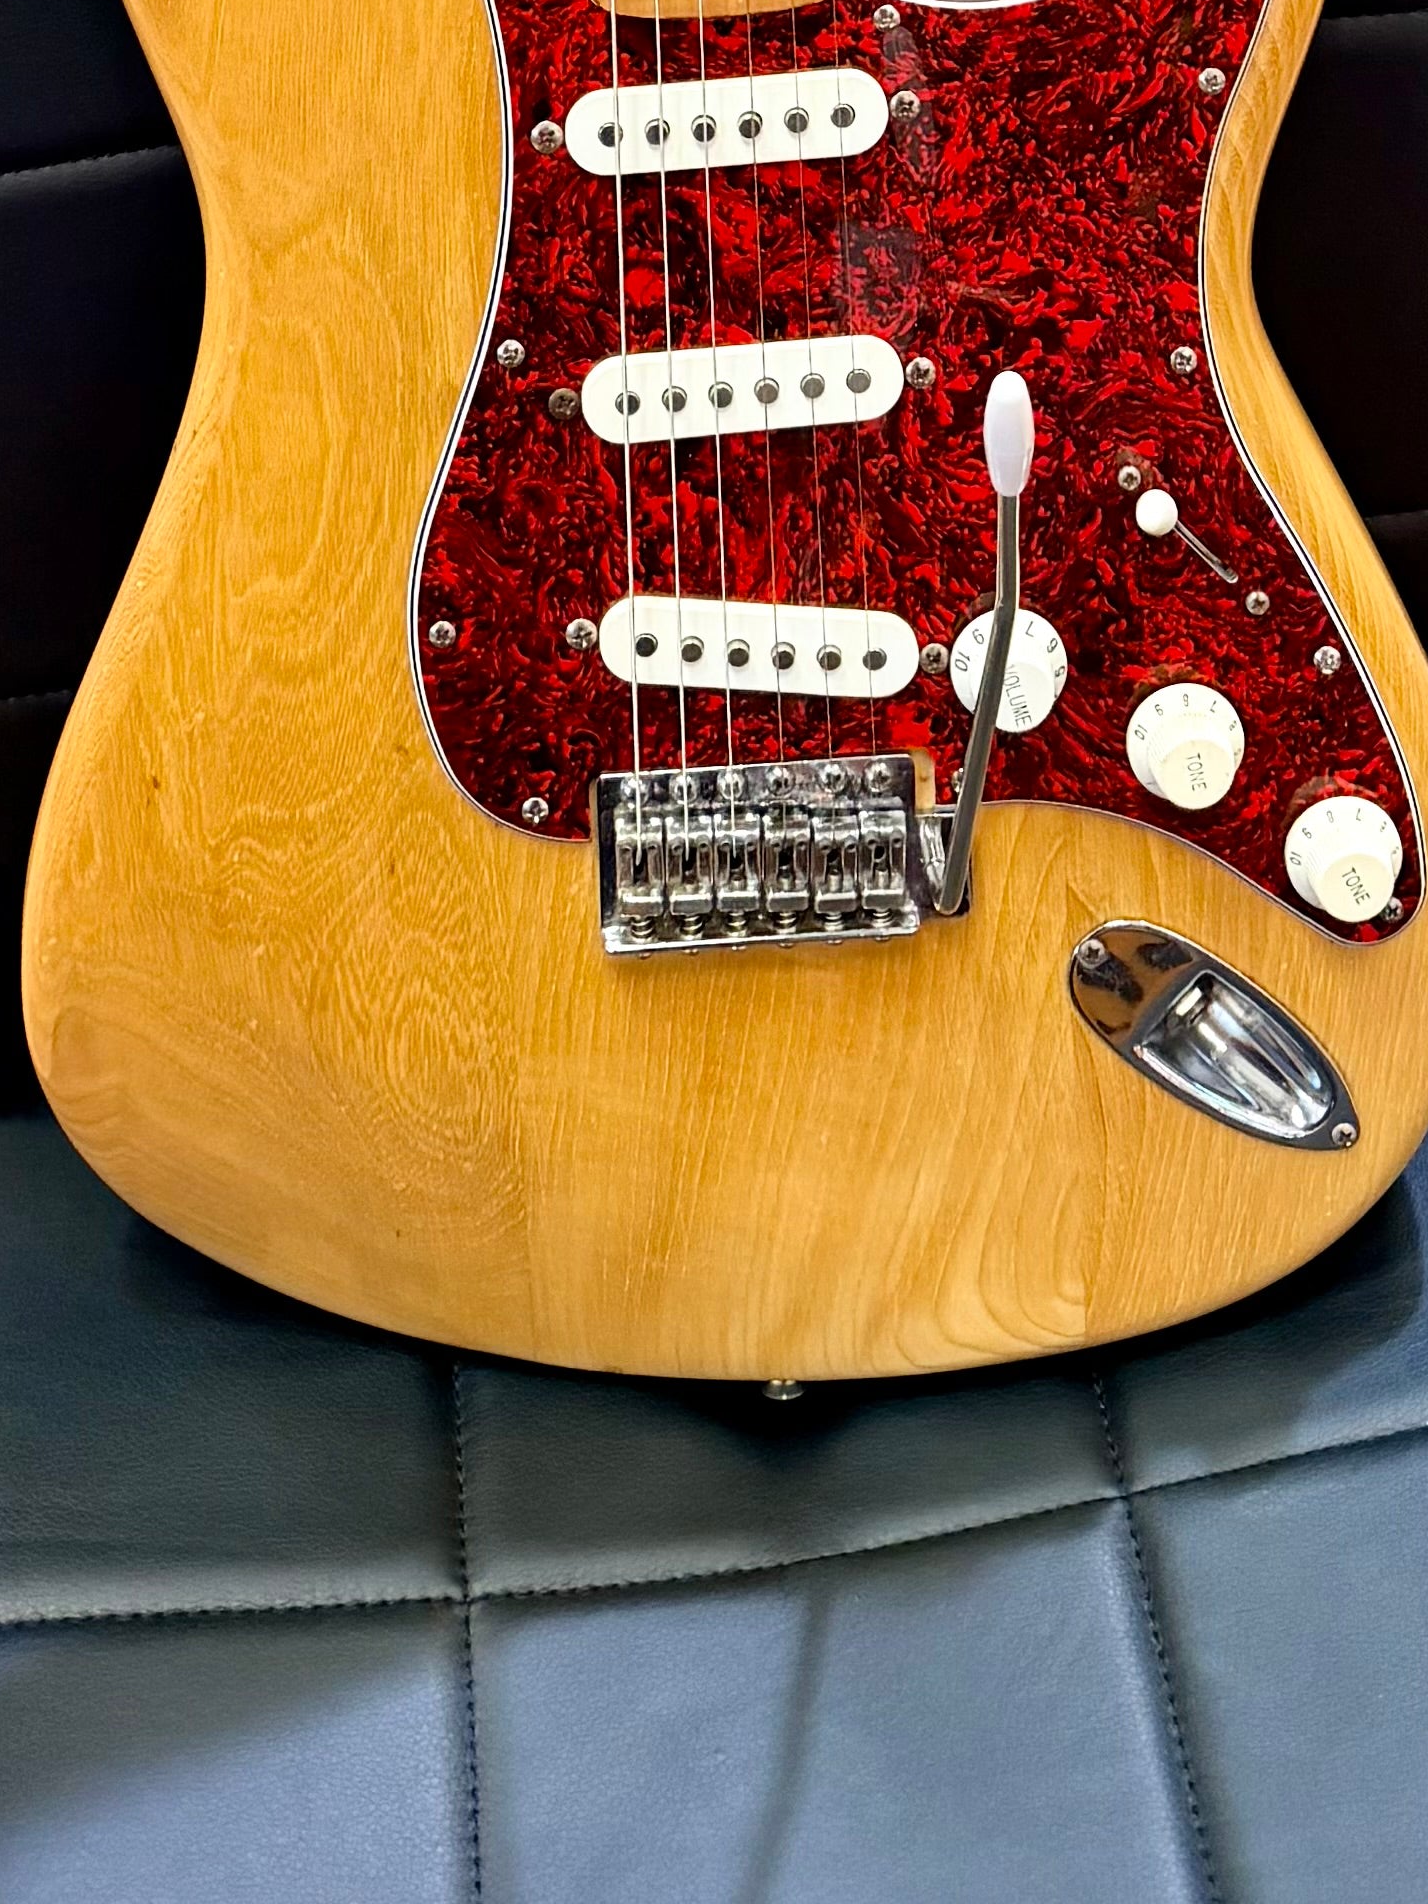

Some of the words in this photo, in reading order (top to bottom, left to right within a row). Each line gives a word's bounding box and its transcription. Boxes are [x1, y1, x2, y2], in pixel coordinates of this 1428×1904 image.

[954, 650, 971, 673] 10
[1134, 723, 1149, 741] 10
[1186, 752, 1208, 793] TONE
[1289, 850, 1302, 867] 10
[1341, 866, 1372, 906] TONE
